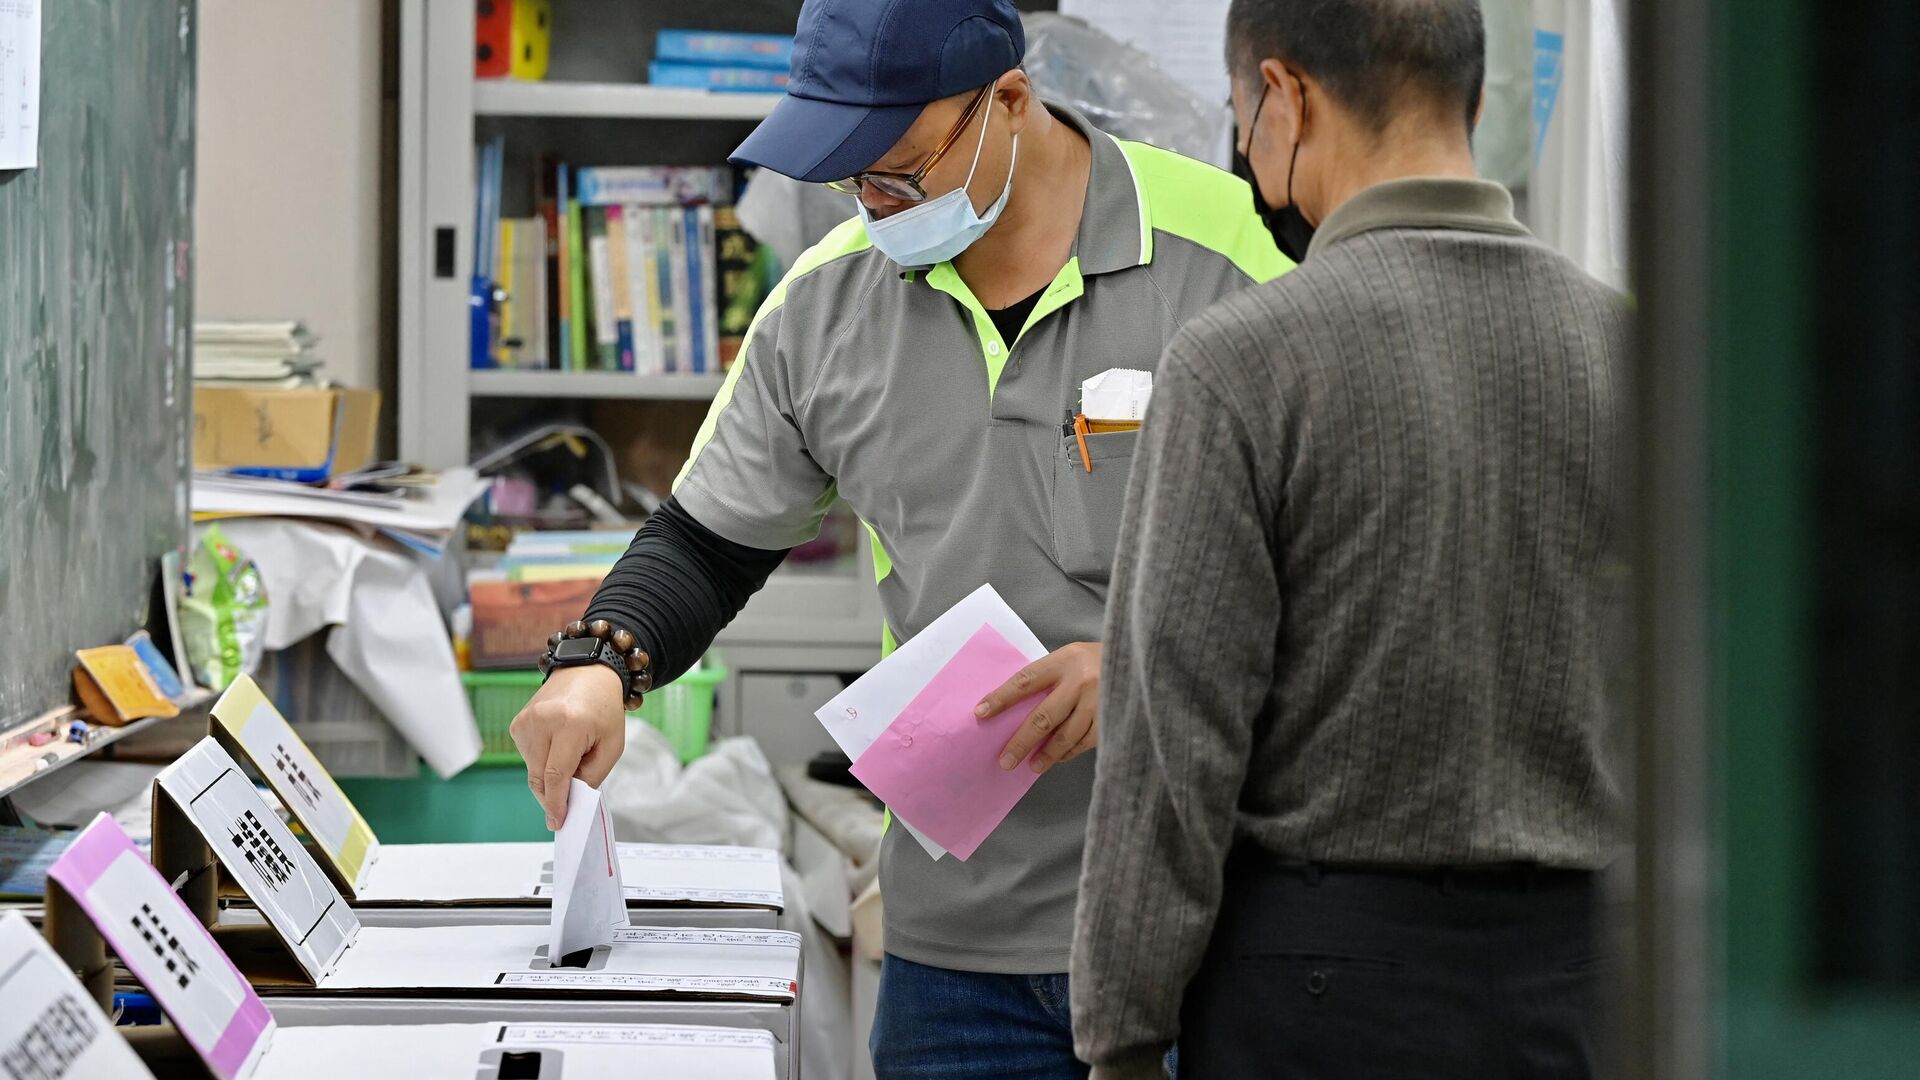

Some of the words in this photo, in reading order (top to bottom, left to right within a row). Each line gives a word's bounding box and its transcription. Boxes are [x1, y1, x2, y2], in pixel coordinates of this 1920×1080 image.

[272, 743, 322, 810] 市長
[227, 810, 296, 892] 市議員
[130, 904, 199, 989] 里長
